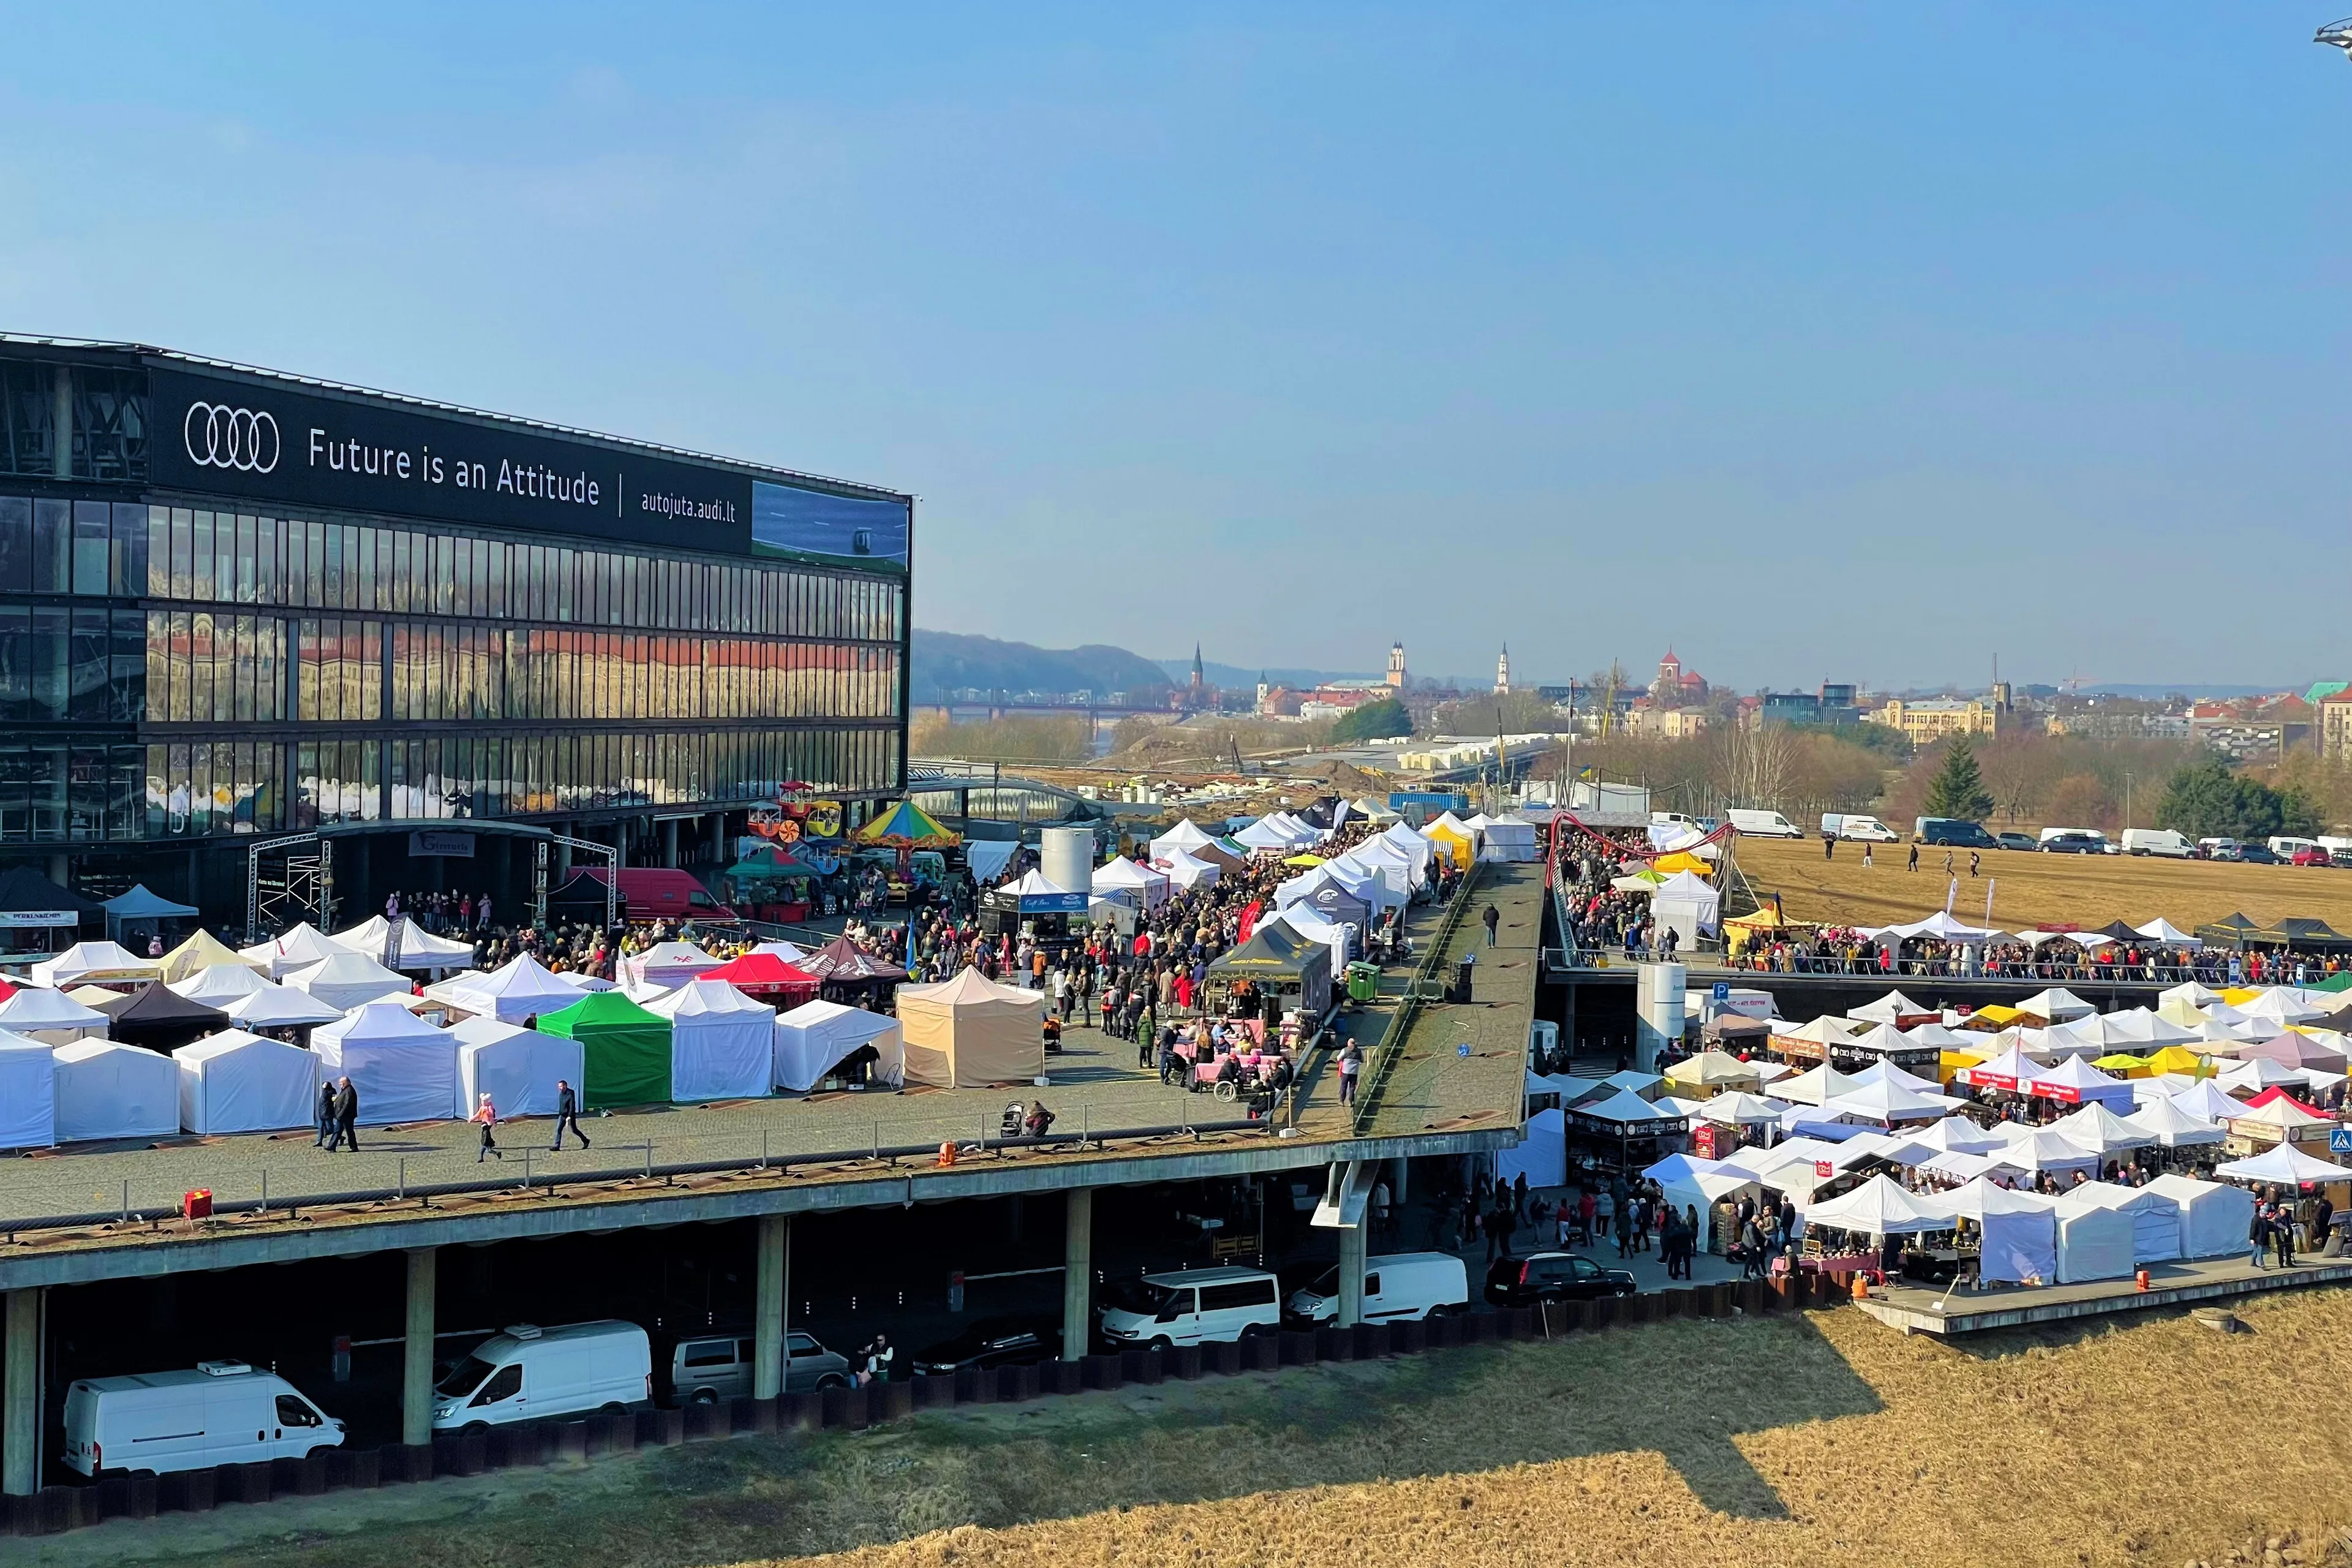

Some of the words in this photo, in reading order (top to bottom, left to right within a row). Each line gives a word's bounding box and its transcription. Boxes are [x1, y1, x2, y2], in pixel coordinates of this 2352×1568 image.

[310, 428, 411, 479] Future
[423, 445, 444, 484] is
[456, 461, 486, 490] an
[497, 458, 600, 505] Attitude
[642, 492, 735, 522] autojuta.audi.lt
[690, 771, 698, 797] 6
[1717, 985, 1726, 998] P
